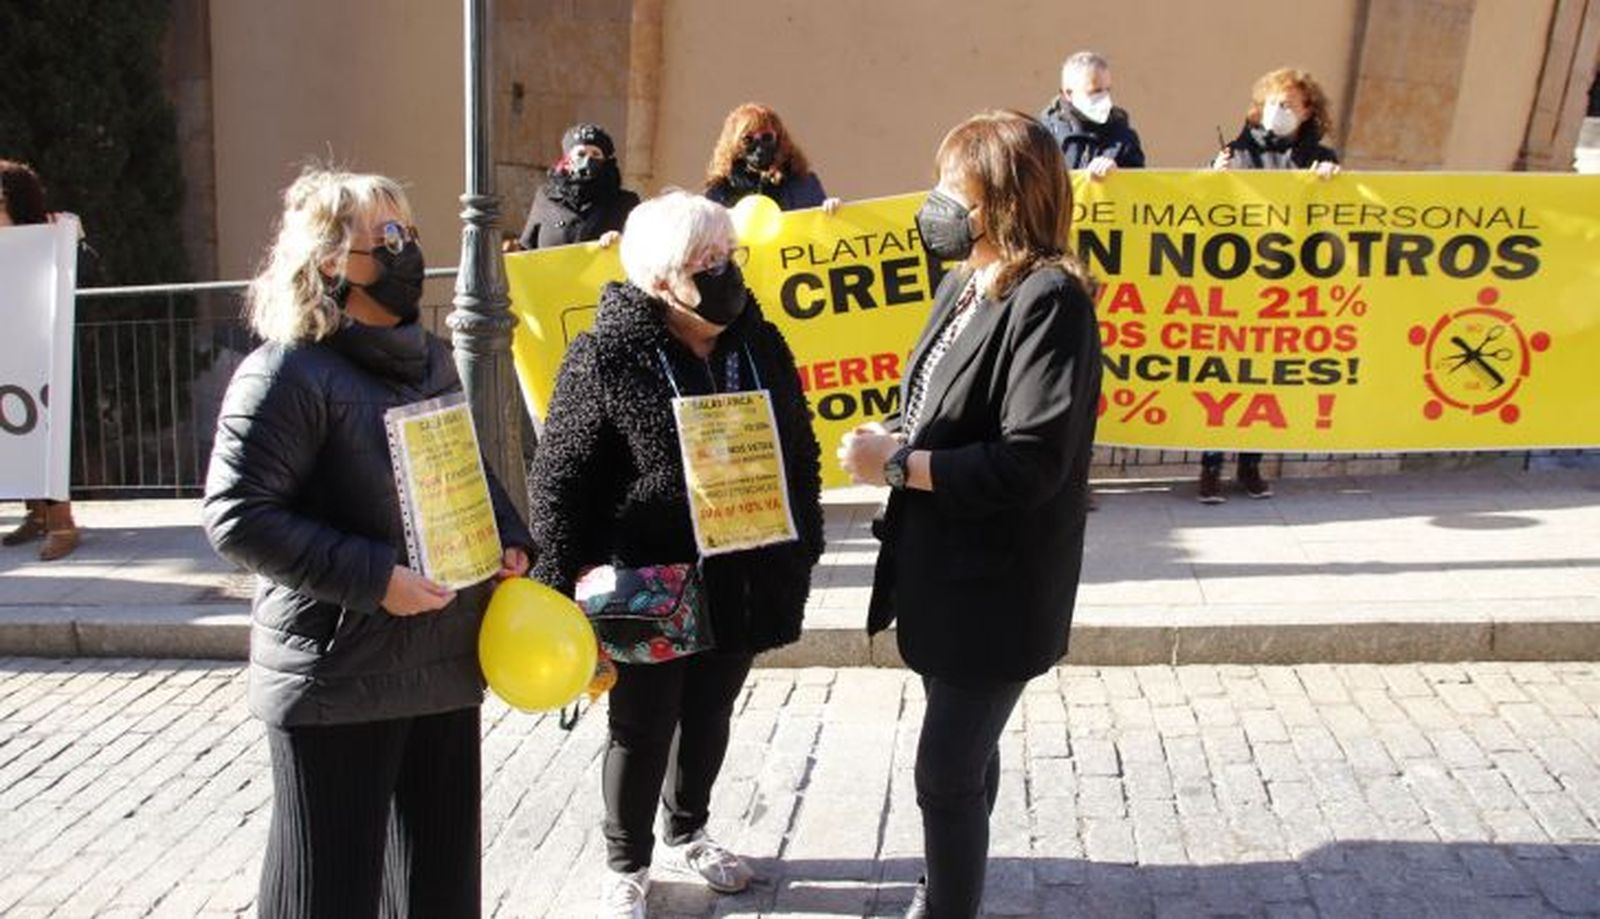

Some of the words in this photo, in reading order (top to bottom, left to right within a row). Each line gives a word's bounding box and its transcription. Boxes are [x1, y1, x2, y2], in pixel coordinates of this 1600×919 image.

[779, 227, 921, 269] PLATAF
[1132, 203, 1291, 227] IMAGEN
[1306, 203, 1541, 230] PERSONAL
[1077, 229, 1123, 276] N
[1148, 231, 1543, 281] NOSOTROS
[1163, 285, 1239, 318] AL
[1258, 284, 1367, 319] 21%
[1098, 321, 1147, 348] OS
[1160, 323, 1358, 353] CENTROS
[1101, 354, 1360, 386] NCIALES!
[1193, 391, 1288, 430] YA
[1315, 394, 1336, 430] !
